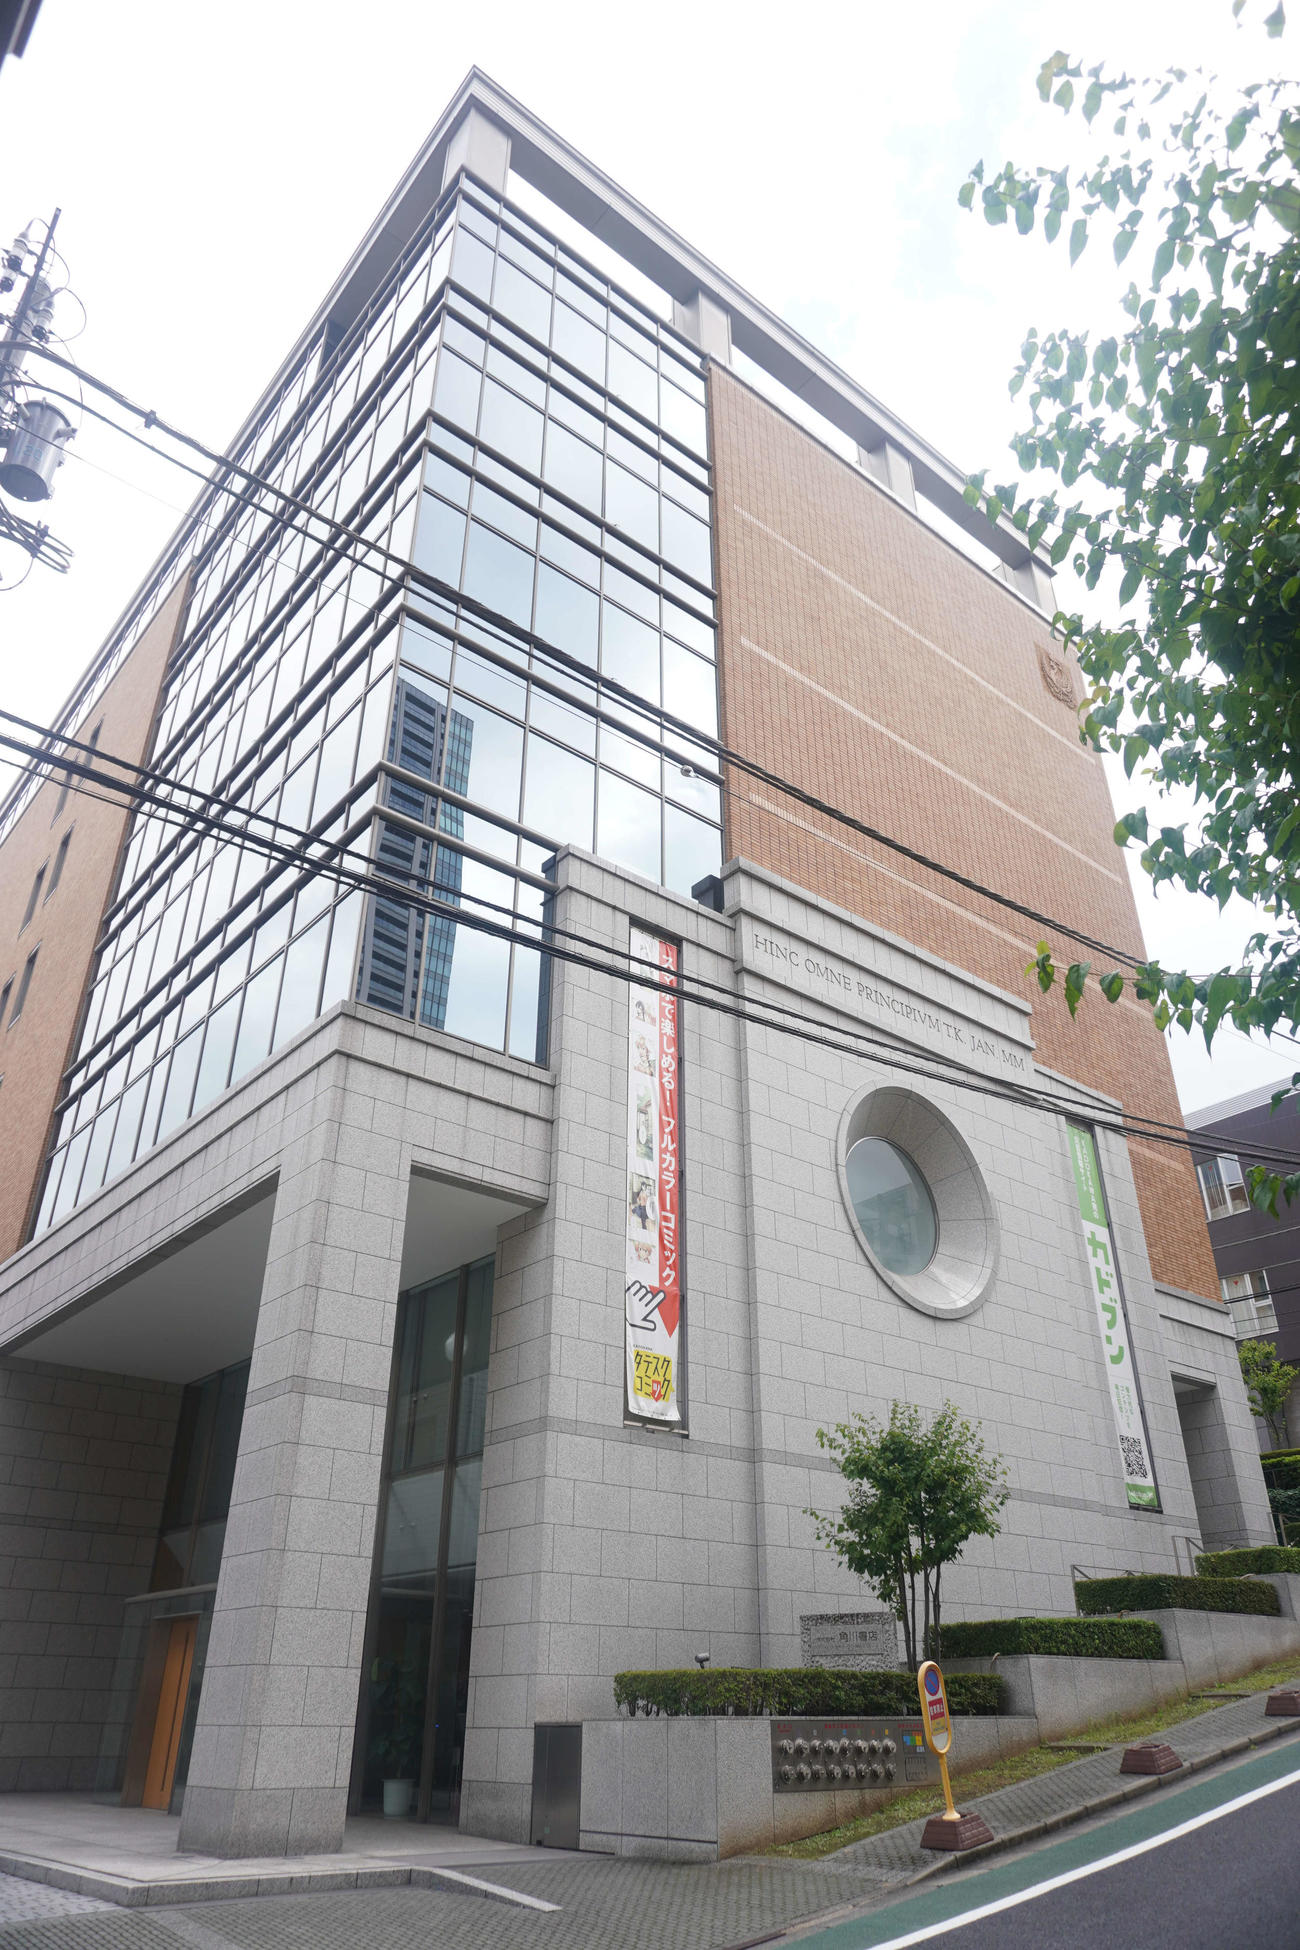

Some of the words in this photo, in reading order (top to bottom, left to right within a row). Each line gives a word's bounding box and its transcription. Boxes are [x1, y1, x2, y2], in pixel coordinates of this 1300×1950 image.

[754, 933, 800, 967] HINC
[804, 958, 852, 992] OMNE
[857, 981, 941, 1033] PRINCIPIVM
[1001, 1049, 1025, 1072] MM
[660, 1116, 676, 1287] フルカラーコミック
[634, 1350, 671, 1378] タテスク
[1087, 1230, 1125, 1365] カドブン
[636, 1374, 671, 1400] コミック
